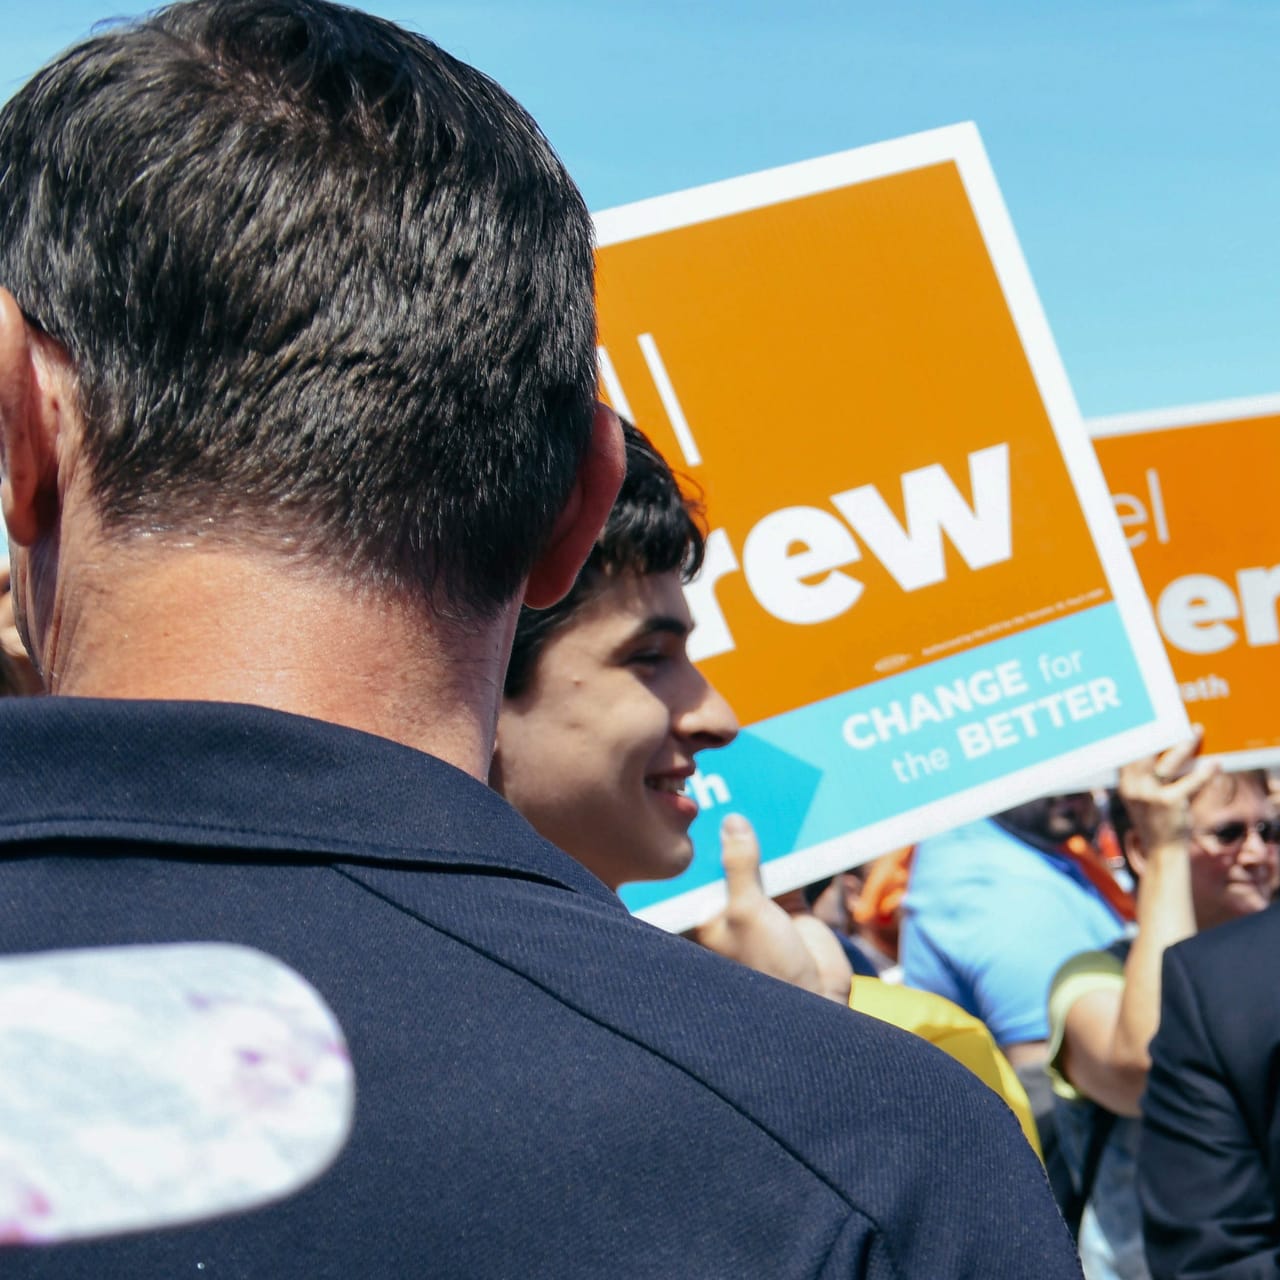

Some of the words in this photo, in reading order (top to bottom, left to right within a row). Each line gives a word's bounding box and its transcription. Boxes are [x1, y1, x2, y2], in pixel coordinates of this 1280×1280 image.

[683, 441, 1013, 660] rew
[842, 660, 1029, 749] CHANGE
[1038, 650, 1084, 683] for
[890, 747, 949, 784] the
[957, 676, 1121, 760] BETTER
[1177, 673, 1231, 702] ath
